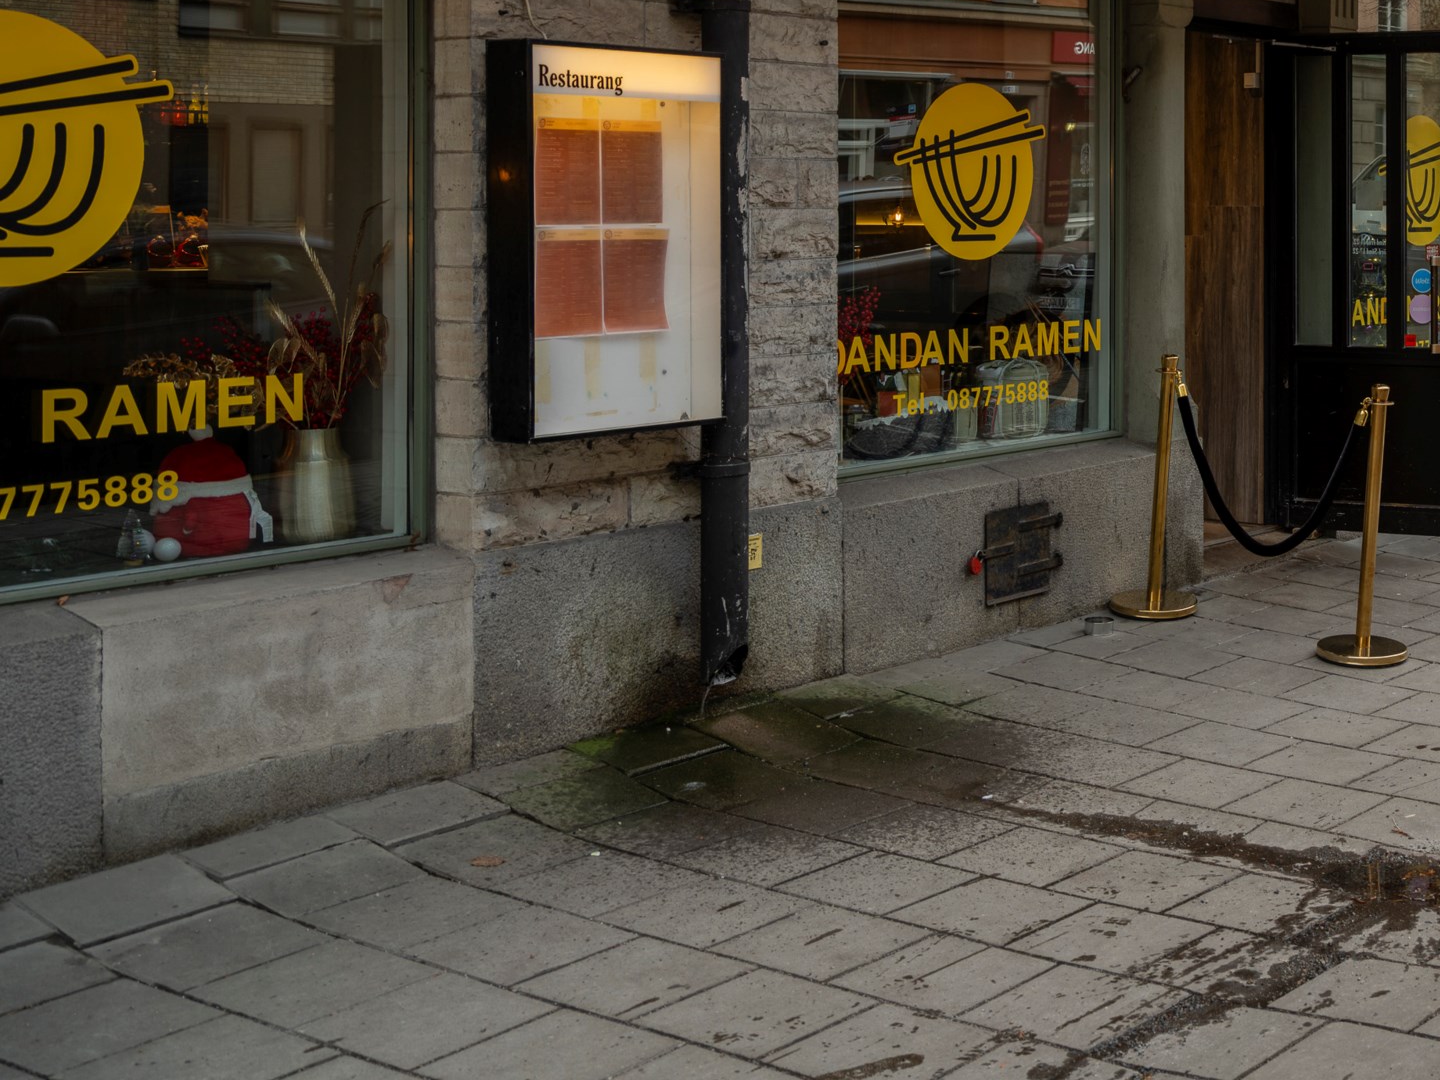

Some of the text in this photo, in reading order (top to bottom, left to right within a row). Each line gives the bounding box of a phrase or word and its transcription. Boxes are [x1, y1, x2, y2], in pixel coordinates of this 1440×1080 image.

[538, 64, 623, 96] Restaurang
[989, 319, 1101, 361] RAMEN
[41, 373, 304, 444] RAMEN
[893, 379, 1050, 417] Tel: 087775888
[0, 470, 179, 521] 7775888
